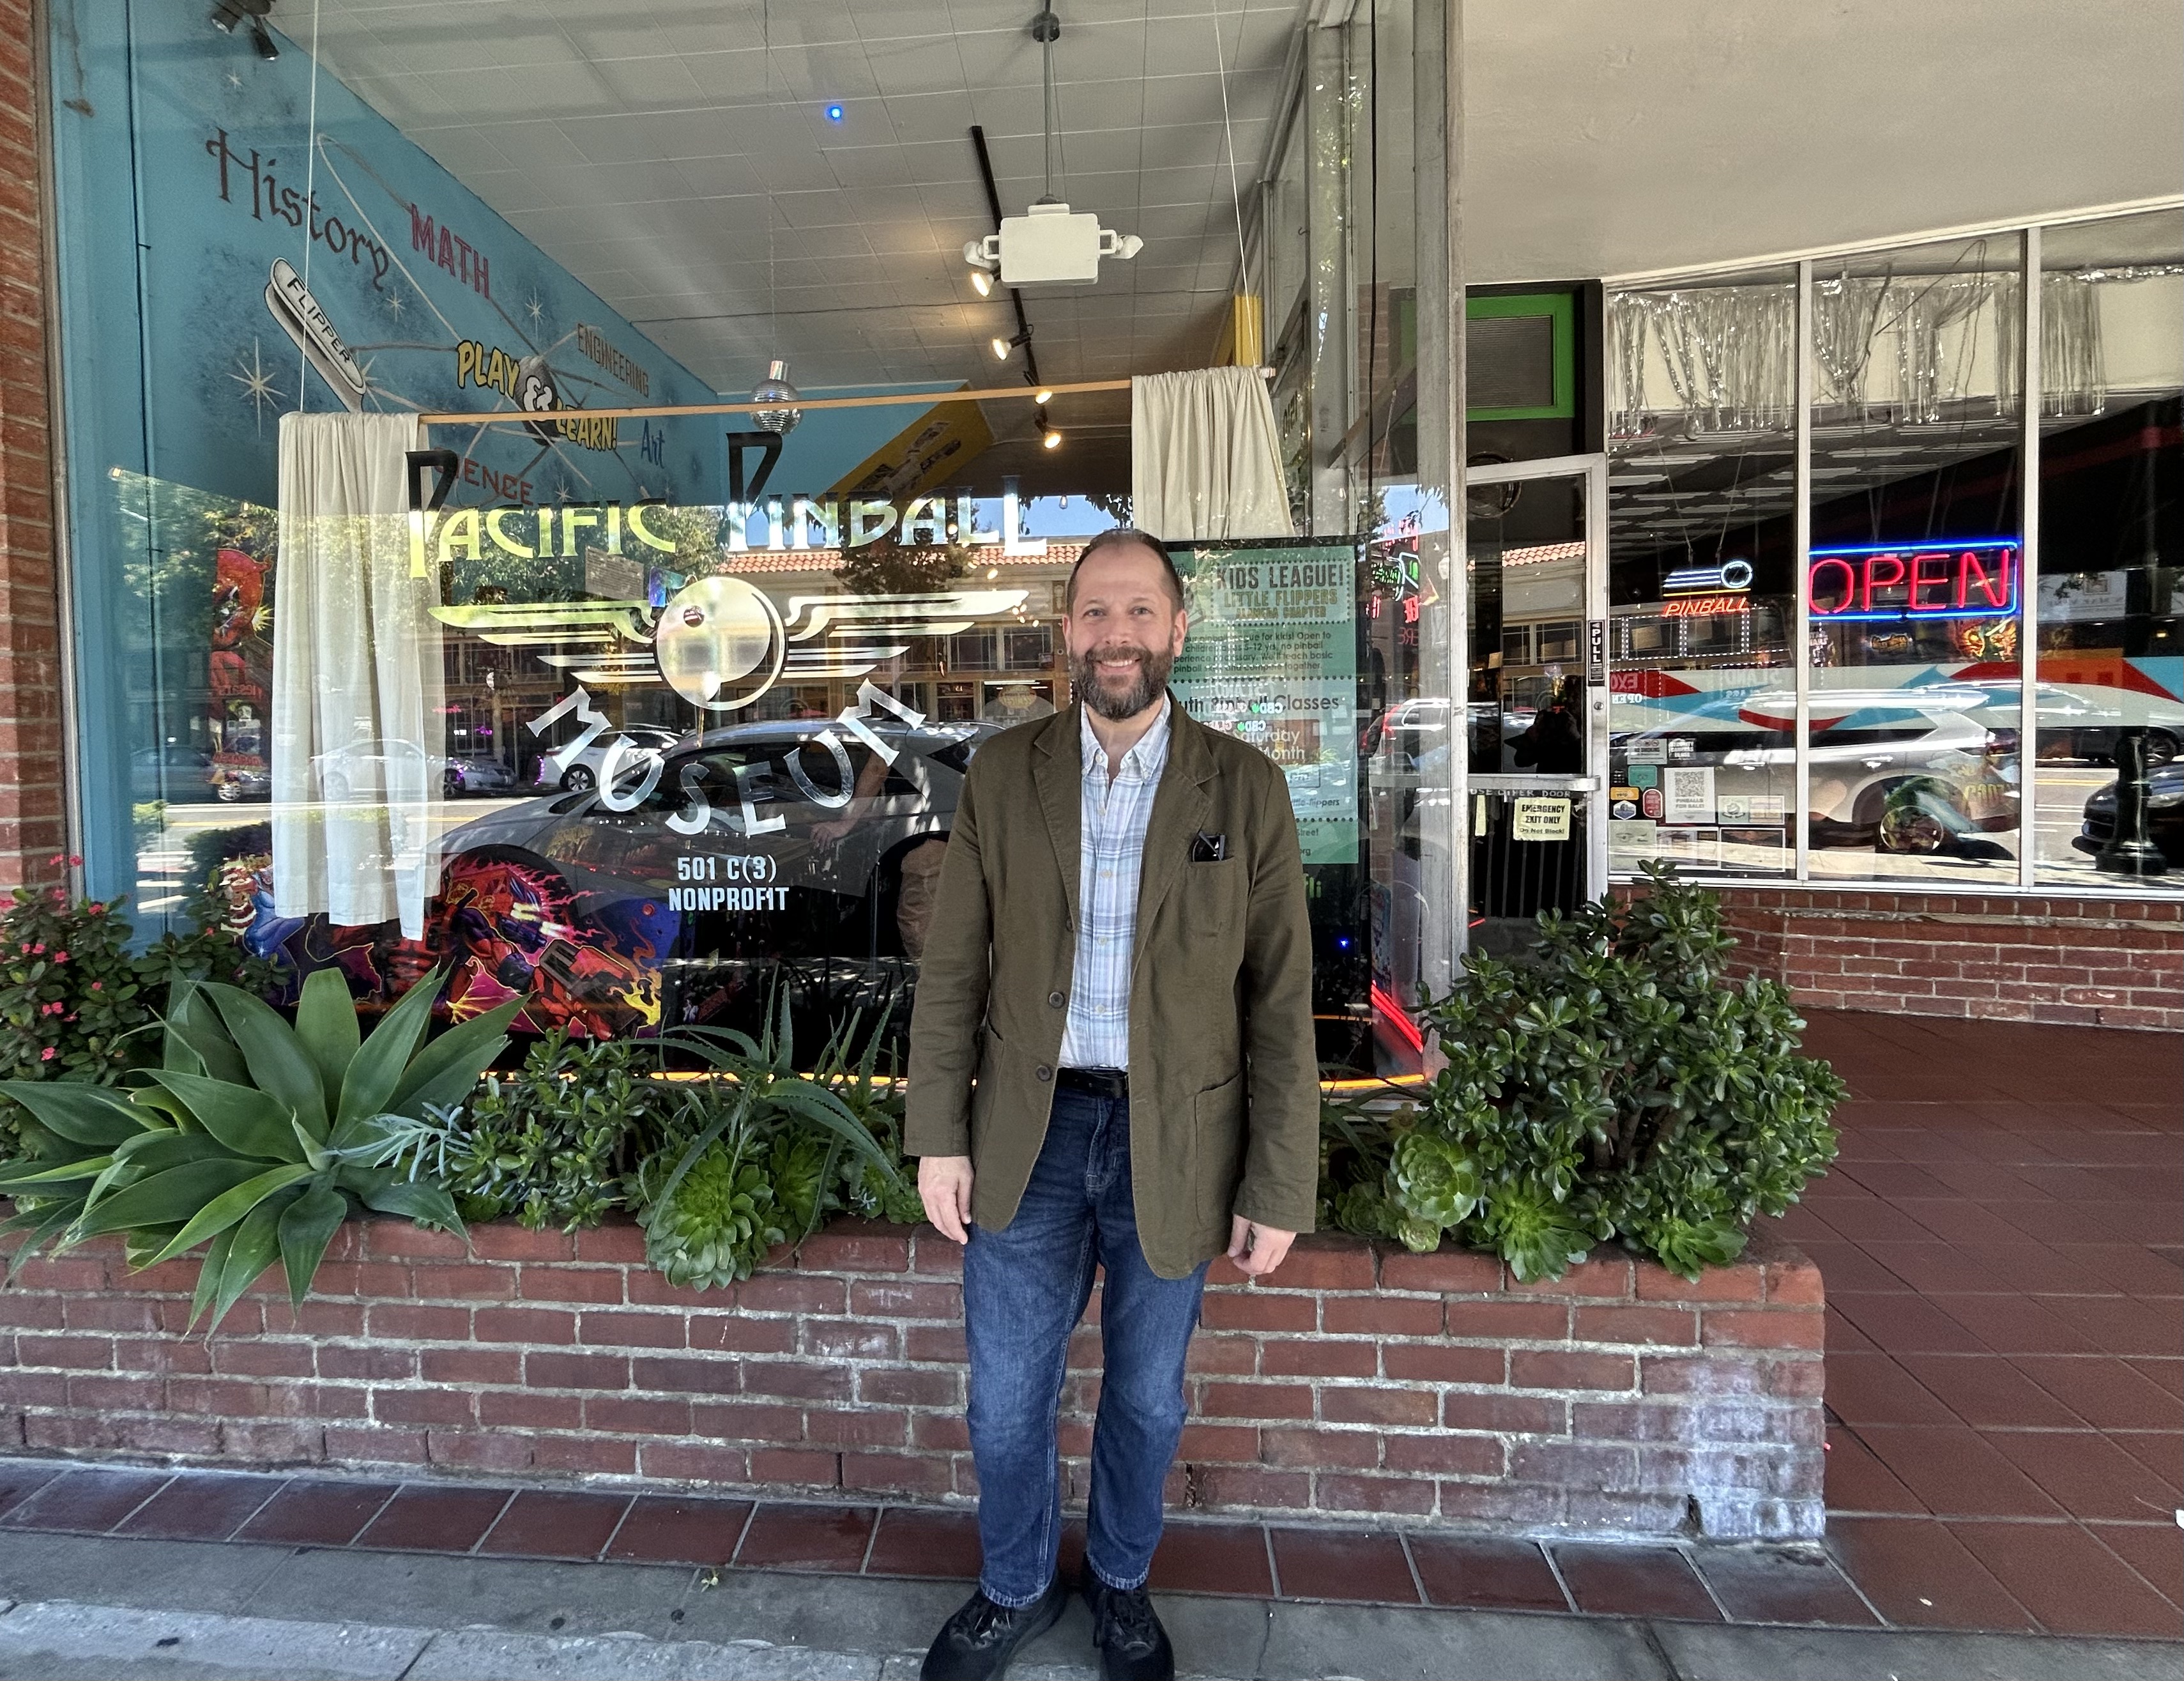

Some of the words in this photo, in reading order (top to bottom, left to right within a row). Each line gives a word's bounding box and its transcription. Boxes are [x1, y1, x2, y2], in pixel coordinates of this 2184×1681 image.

[206, 127, 389, 292] History
[411, 203, 490, 299] MATH
[287, 277, 352, 364] FLIPPER
[457, 339, 520, 398] PLAY
[577, 323, 649, 399] ENGINEERING
[641, 419, 666, 468] Art
[406, 449, 676, 578] PACIFIC
[726, 431, 1048, 556] PINBALL
[1216, 567, 1259, 590] KIDS
[1269, 564, 1344, 588] LEAGUE!
[1808, 548, 2011, 615] OPEN
[1224, 590, 1269, 608] LITTLE
[1275, 588, 1338, 607] FLIPPERS
[1663, 596, 1752, 618] PINBALL
[1262, 632, 1273, 640] for
[1297, 631, 1320, 641] Open
[1323, 631, 1331, 640] to
[1294, 641, 1323, 651] pinball
[1591, 628, 1601, 663] PULL
[1310, 651, 1333, 659] basic
[1173, 664, 1202, 675] pinball
[1273, 694, 1339, 710] Classes
[526, 677, 927, 837] MUSEUM
[1521, 804, 1566, 813] EMERGENCY
[1525, 815, 1542, 824] EXIT
[1543, 815, 1561, 824] ONLY
[677, 857, 716, 881] 501
[727, 854, 777, 884] C(3)
[668, 886, 790, 912] NONPROFIT
